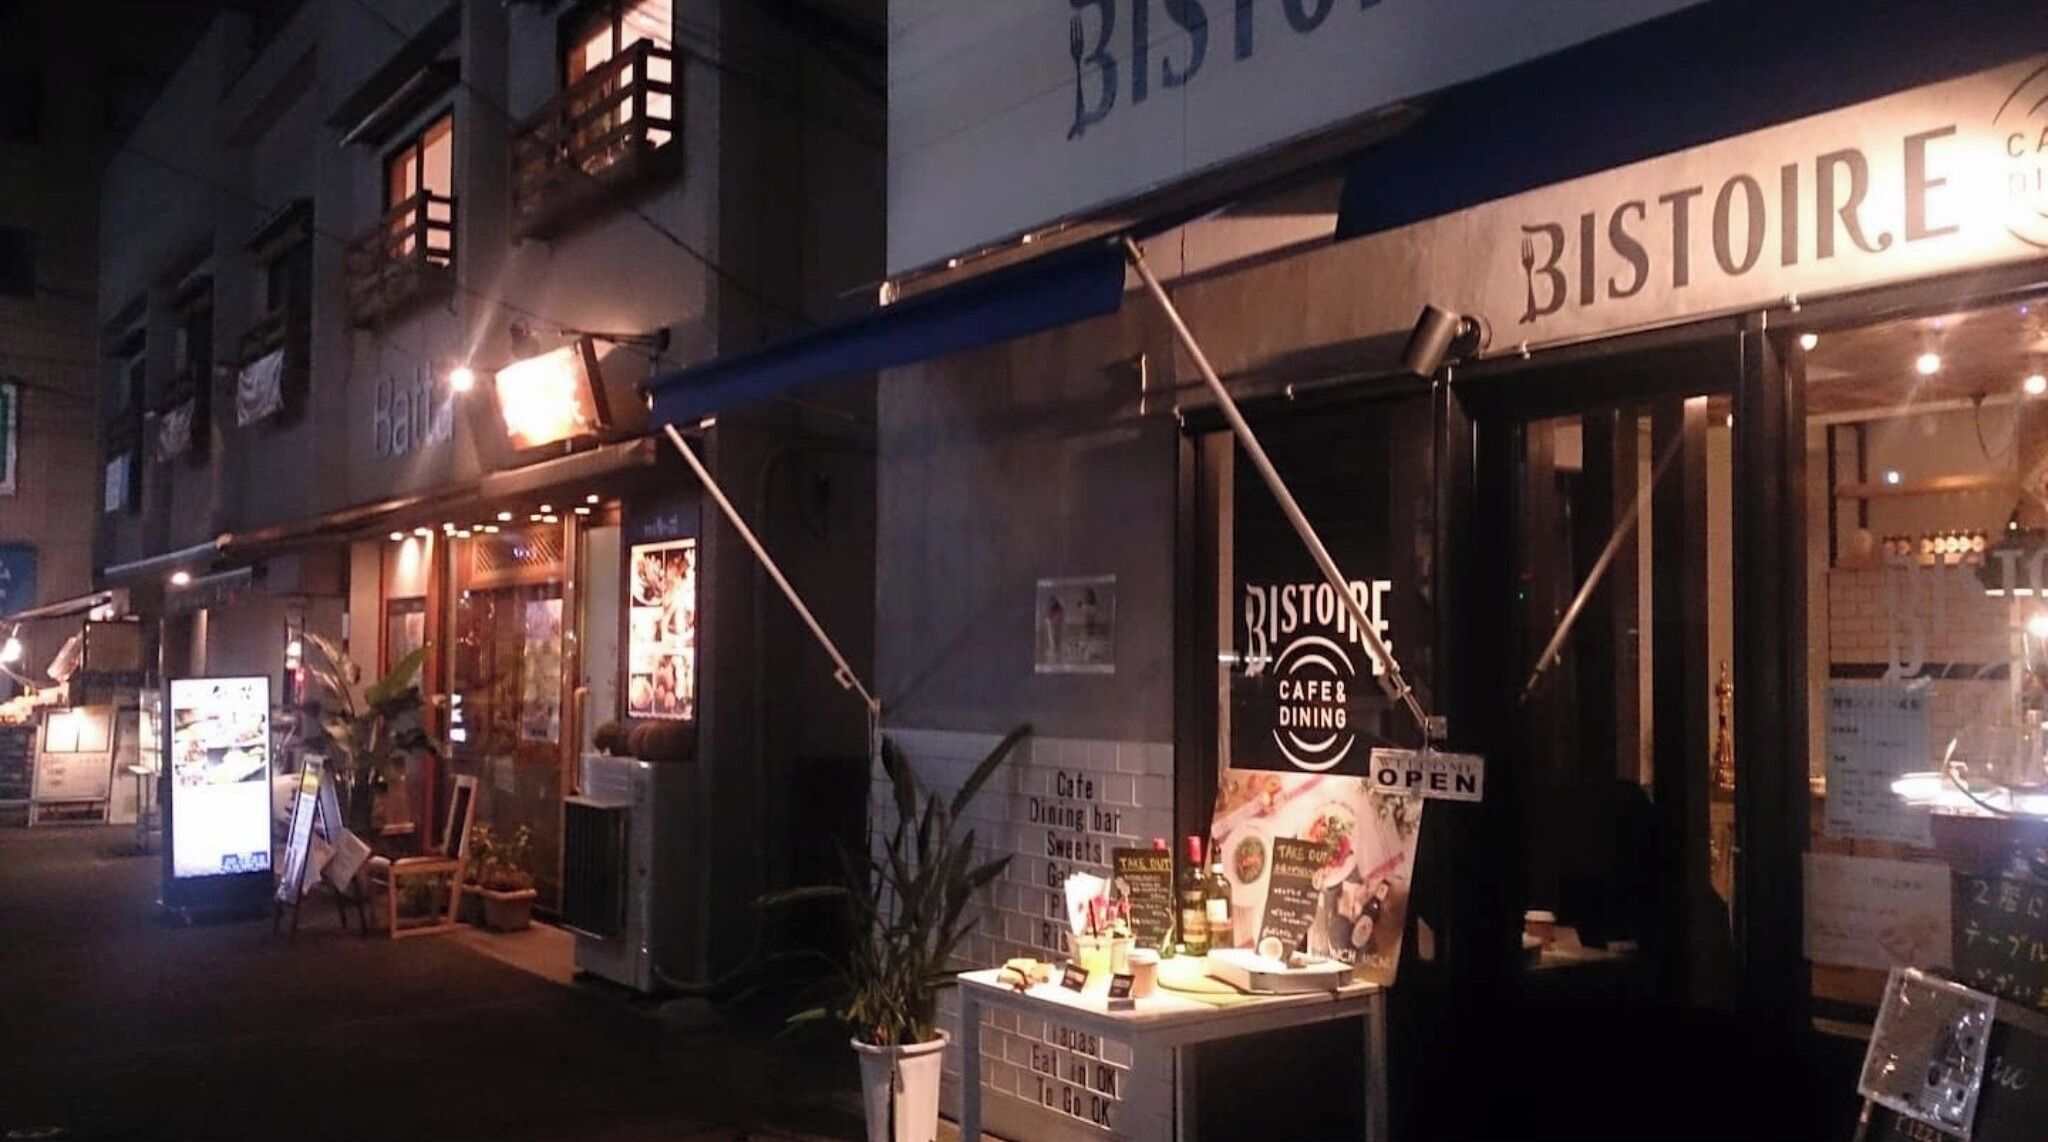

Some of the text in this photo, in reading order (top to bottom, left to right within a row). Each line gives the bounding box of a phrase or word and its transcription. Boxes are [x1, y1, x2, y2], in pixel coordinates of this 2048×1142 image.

[1519, 124, 1960, 324] BISTOIRE
[1279, 706, 1347, 729] DINING
[1057, 771, 1093, 799] Cafe
[1378, 768, 1475, 793] OPEN
[1030, 797, 1121, 833] Dining bar
[1047, 831, 1101, 863] Sweets
[1032, 1044, 1116, 1098] Eat in OK
[1036, 1077, 1111, 1127] To Go OK
